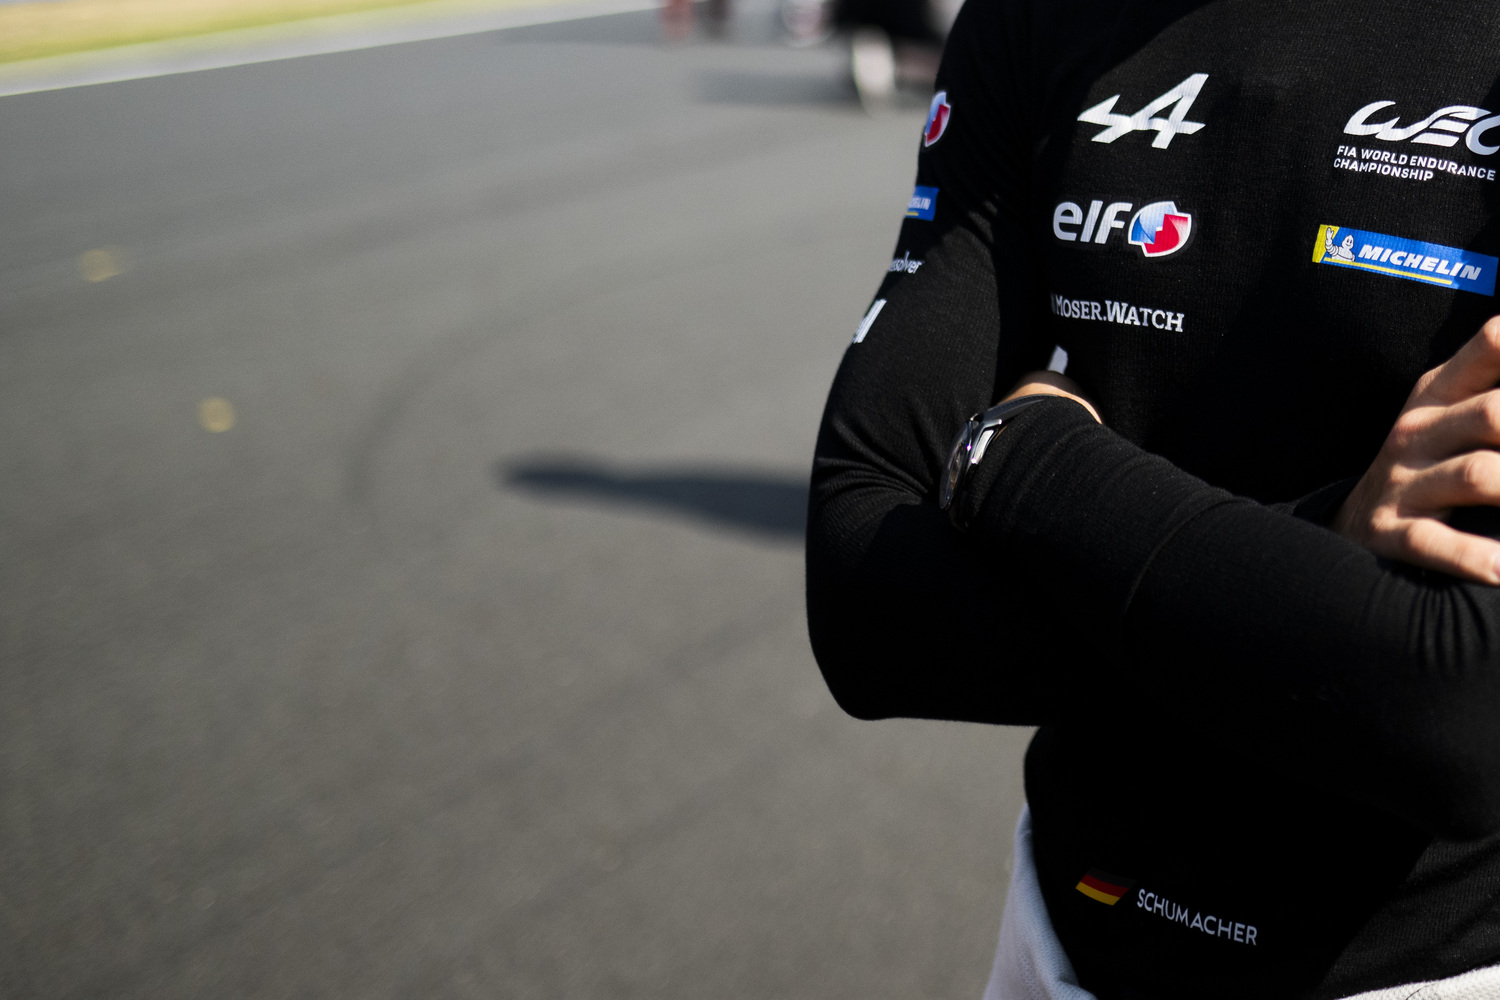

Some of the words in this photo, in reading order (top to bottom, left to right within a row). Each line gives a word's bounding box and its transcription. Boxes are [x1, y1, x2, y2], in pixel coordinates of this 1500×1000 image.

[1333, 158, 1434, 182] CHAMPIONSHIP
[1336, 145, 1357, 158] FIA
[1361, 148, 1408, 165] WORLD
[1409, 156, 1497, 181] ENDURANCE
[1052, 199, 1132, 245] elf
[1358, 244, 1483, 282] MICHELIN
[1137, 887, 1258, 946] SCHUMACHER
